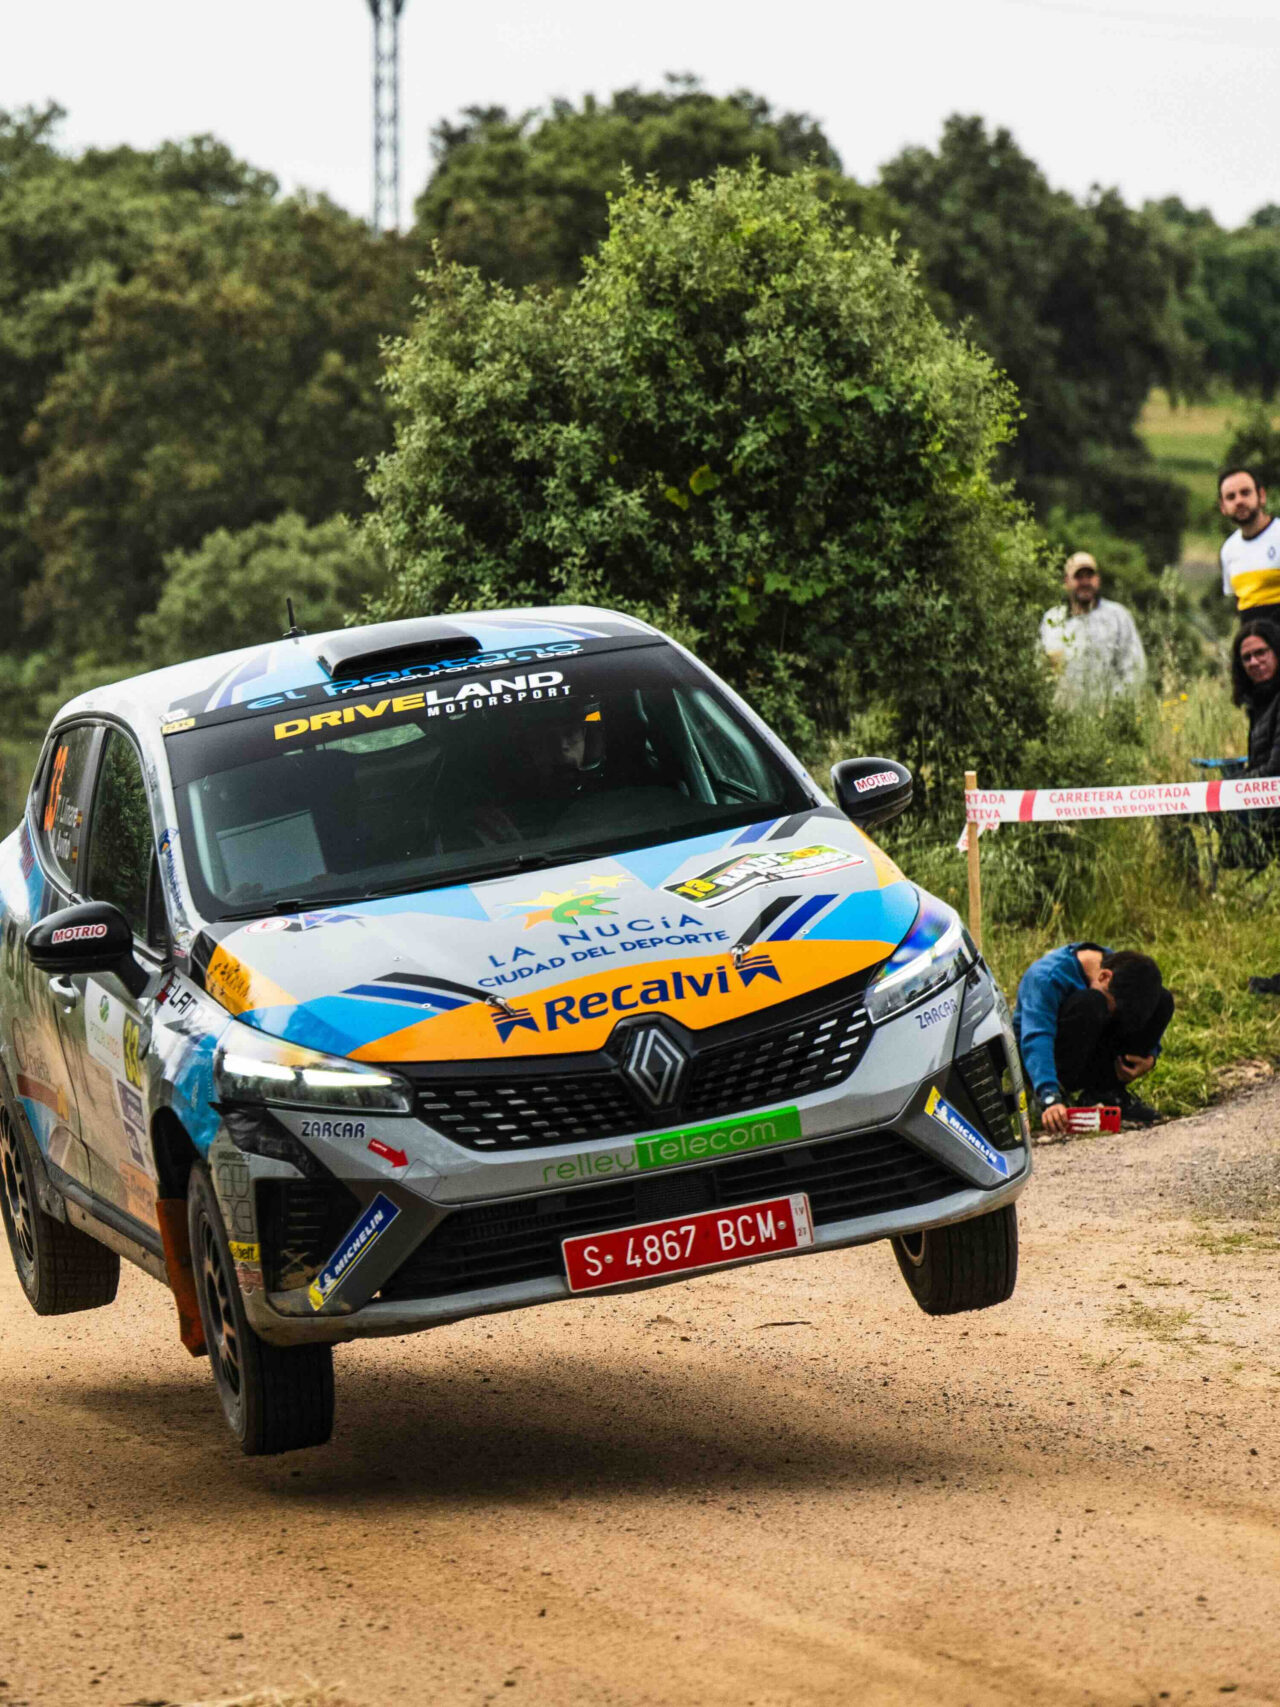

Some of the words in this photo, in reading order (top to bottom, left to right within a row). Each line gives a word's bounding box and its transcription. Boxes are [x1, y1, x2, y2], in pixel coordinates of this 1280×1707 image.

[273, 670, 565, 741] DRIVELAND
[427, 684, 573, 718] MOTORSPORT
[854, 770, 899, 792] MOTRIO
[1049, 789, 1123, 804] CARRETERA
[1129, 786, 1191, 801] CORTADA
[1055, 805, 1106, 818] PRUEBA
[1111, 801, 1189, 815] DEPORTIVA
[676, 878, 717, 899] 13
[52, 924, 108, 944] MOTRIO
[477, 956, 574, 989] CIUDAD
[571, 944, 616, 963] DEL
[620, 929, 731, 953] DEPORTE
[487, 945, 537, 968] LA
[543, 965, 732, 1033] Recalvi
[301, 1121, 366, 1138] ZARCAR
[643, 1120, 778, 1163] Telecom
[949, 1116, 998, 1164] MICHELIN
[334, 1209, 385, 1276] MICHELIN
[583, 1246, 603, 1277] S
[625, 1224, 697, 1269] 4867
[717, 1210, 777, 1252] BCM
